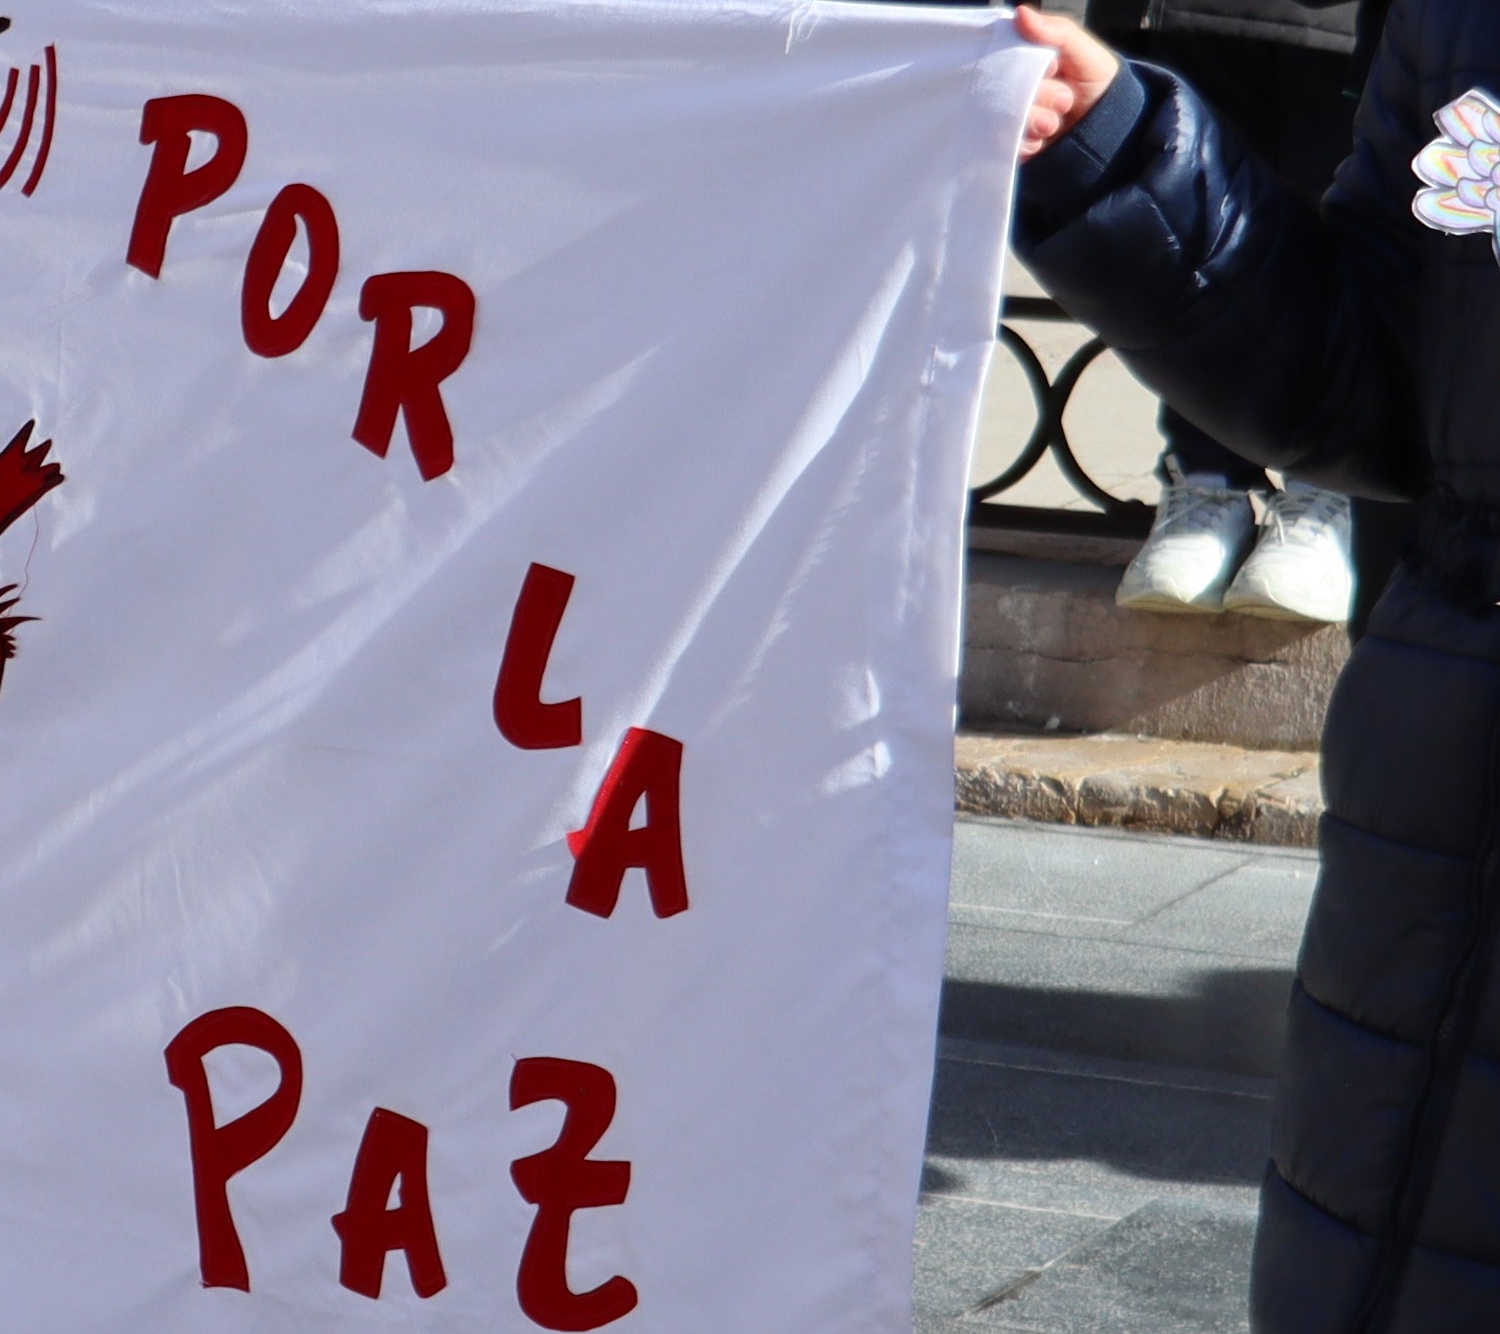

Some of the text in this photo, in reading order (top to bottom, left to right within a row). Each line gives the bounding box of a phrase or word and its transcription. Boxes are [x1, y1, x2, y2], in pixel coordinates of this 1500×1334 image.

[129, 94, 478, 481] POR
[496, 563, 690, 919] LA
[167, 1006, 640, 1333] PAZ
